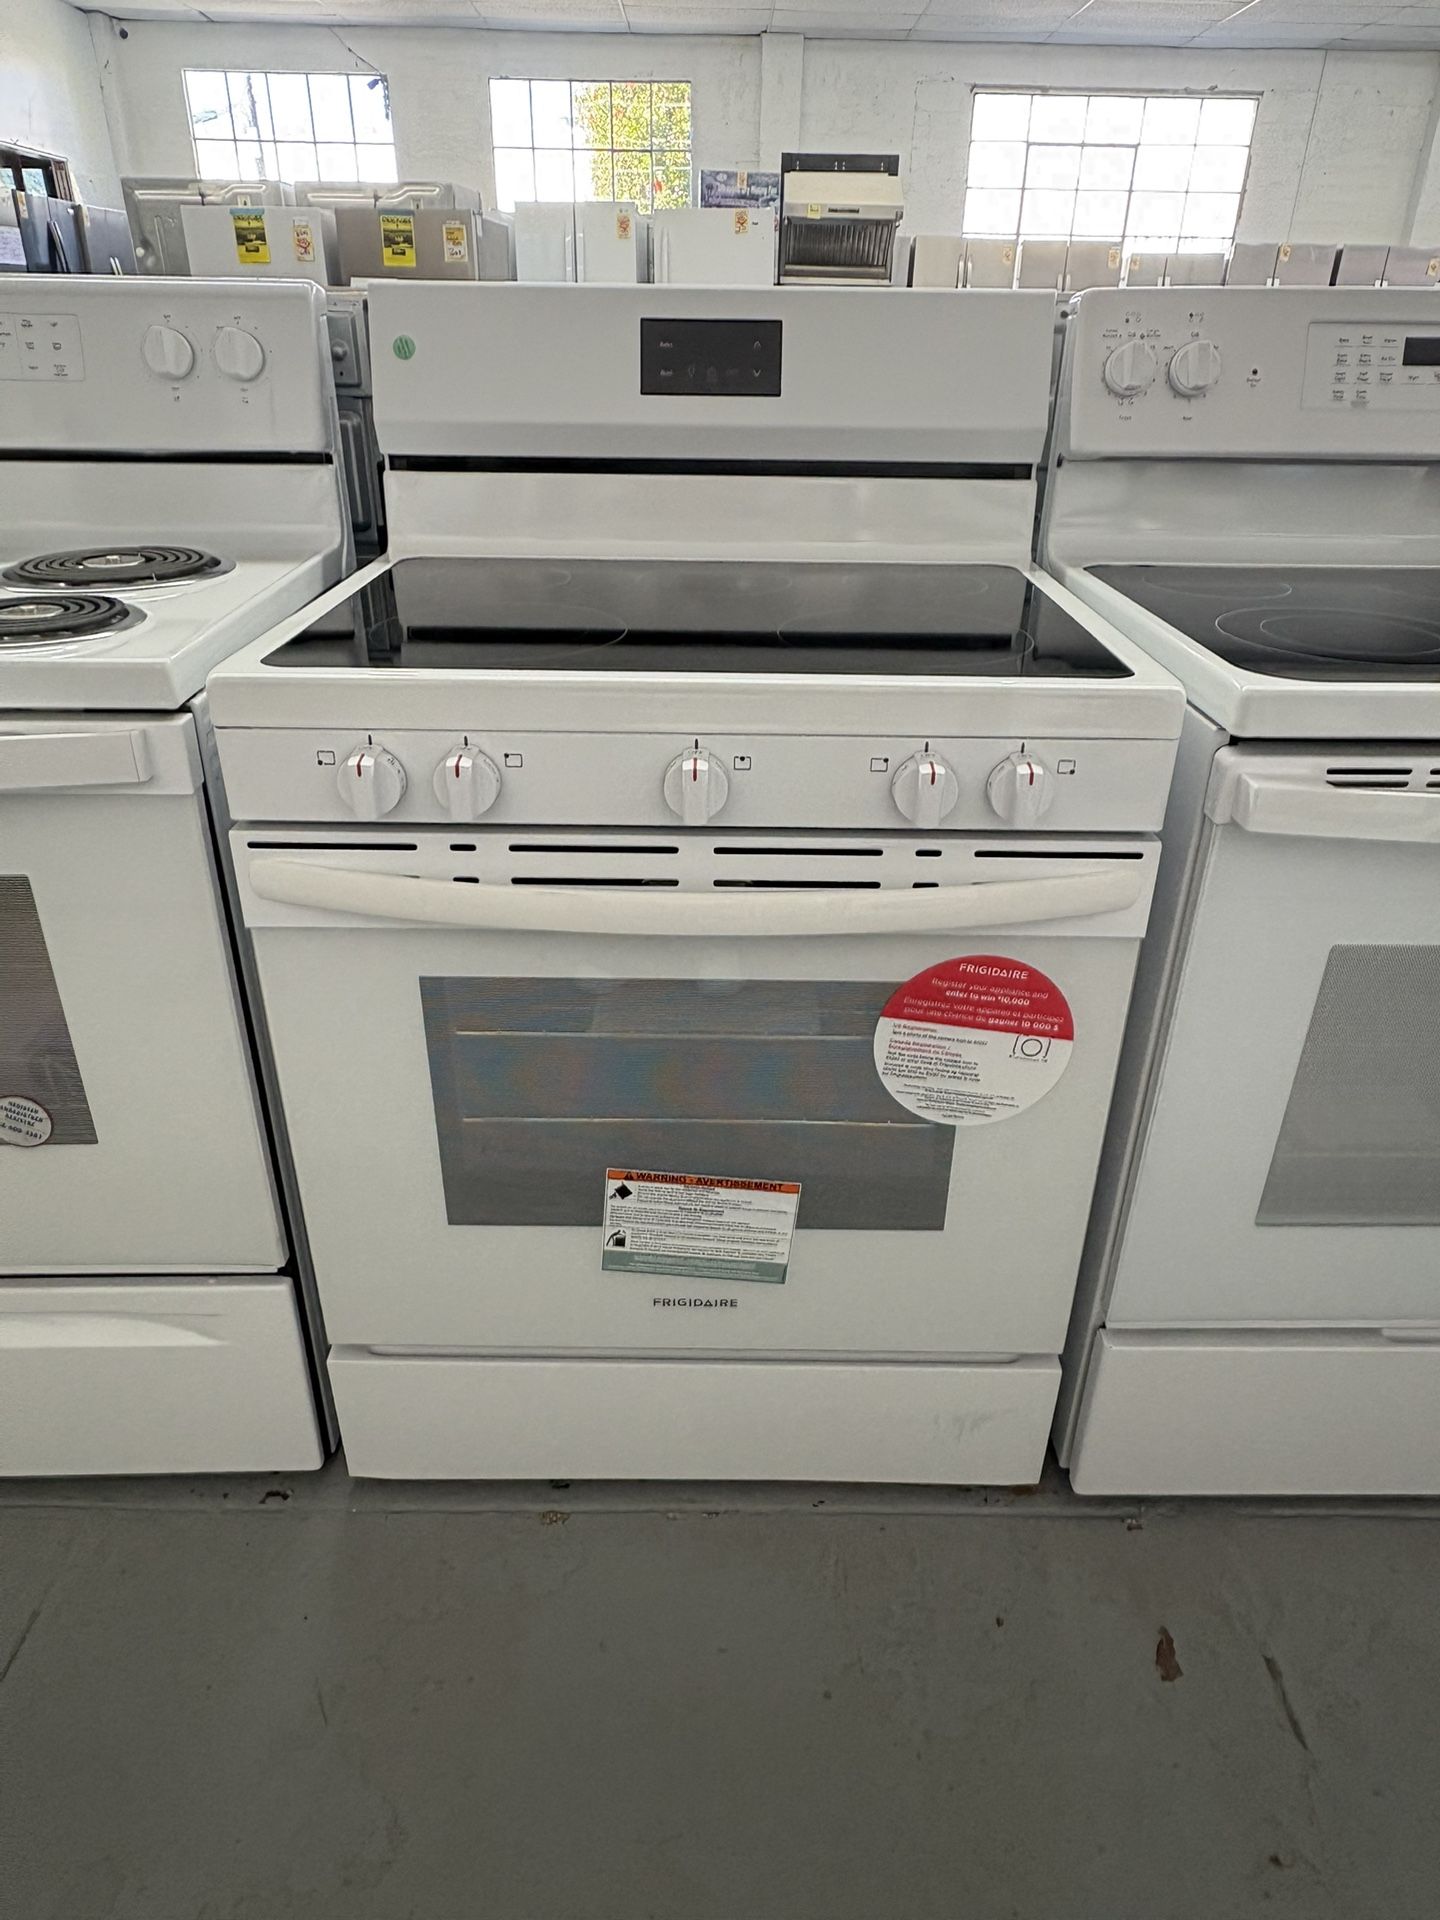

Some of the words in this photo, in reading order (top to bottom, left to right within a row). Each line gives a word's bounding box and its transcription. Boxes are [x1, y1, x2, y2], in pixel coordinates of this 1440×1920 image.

[959, 963, 1029, 980] FRIGIDAIRE
[931, 977, 966, 989] Register
[990, 984, 1031, 997] appliance
[1032, 990, 1049, 999] and
[946, 990, 968, 998] enter
[970, 992, 978, 1000] to
[636, 1173, 687, 1184] WARNING
[697, 1177, 784, 1191] AVERTISSEMENT
[653, 1298, 738, 1308] FRIGIDAIRE
